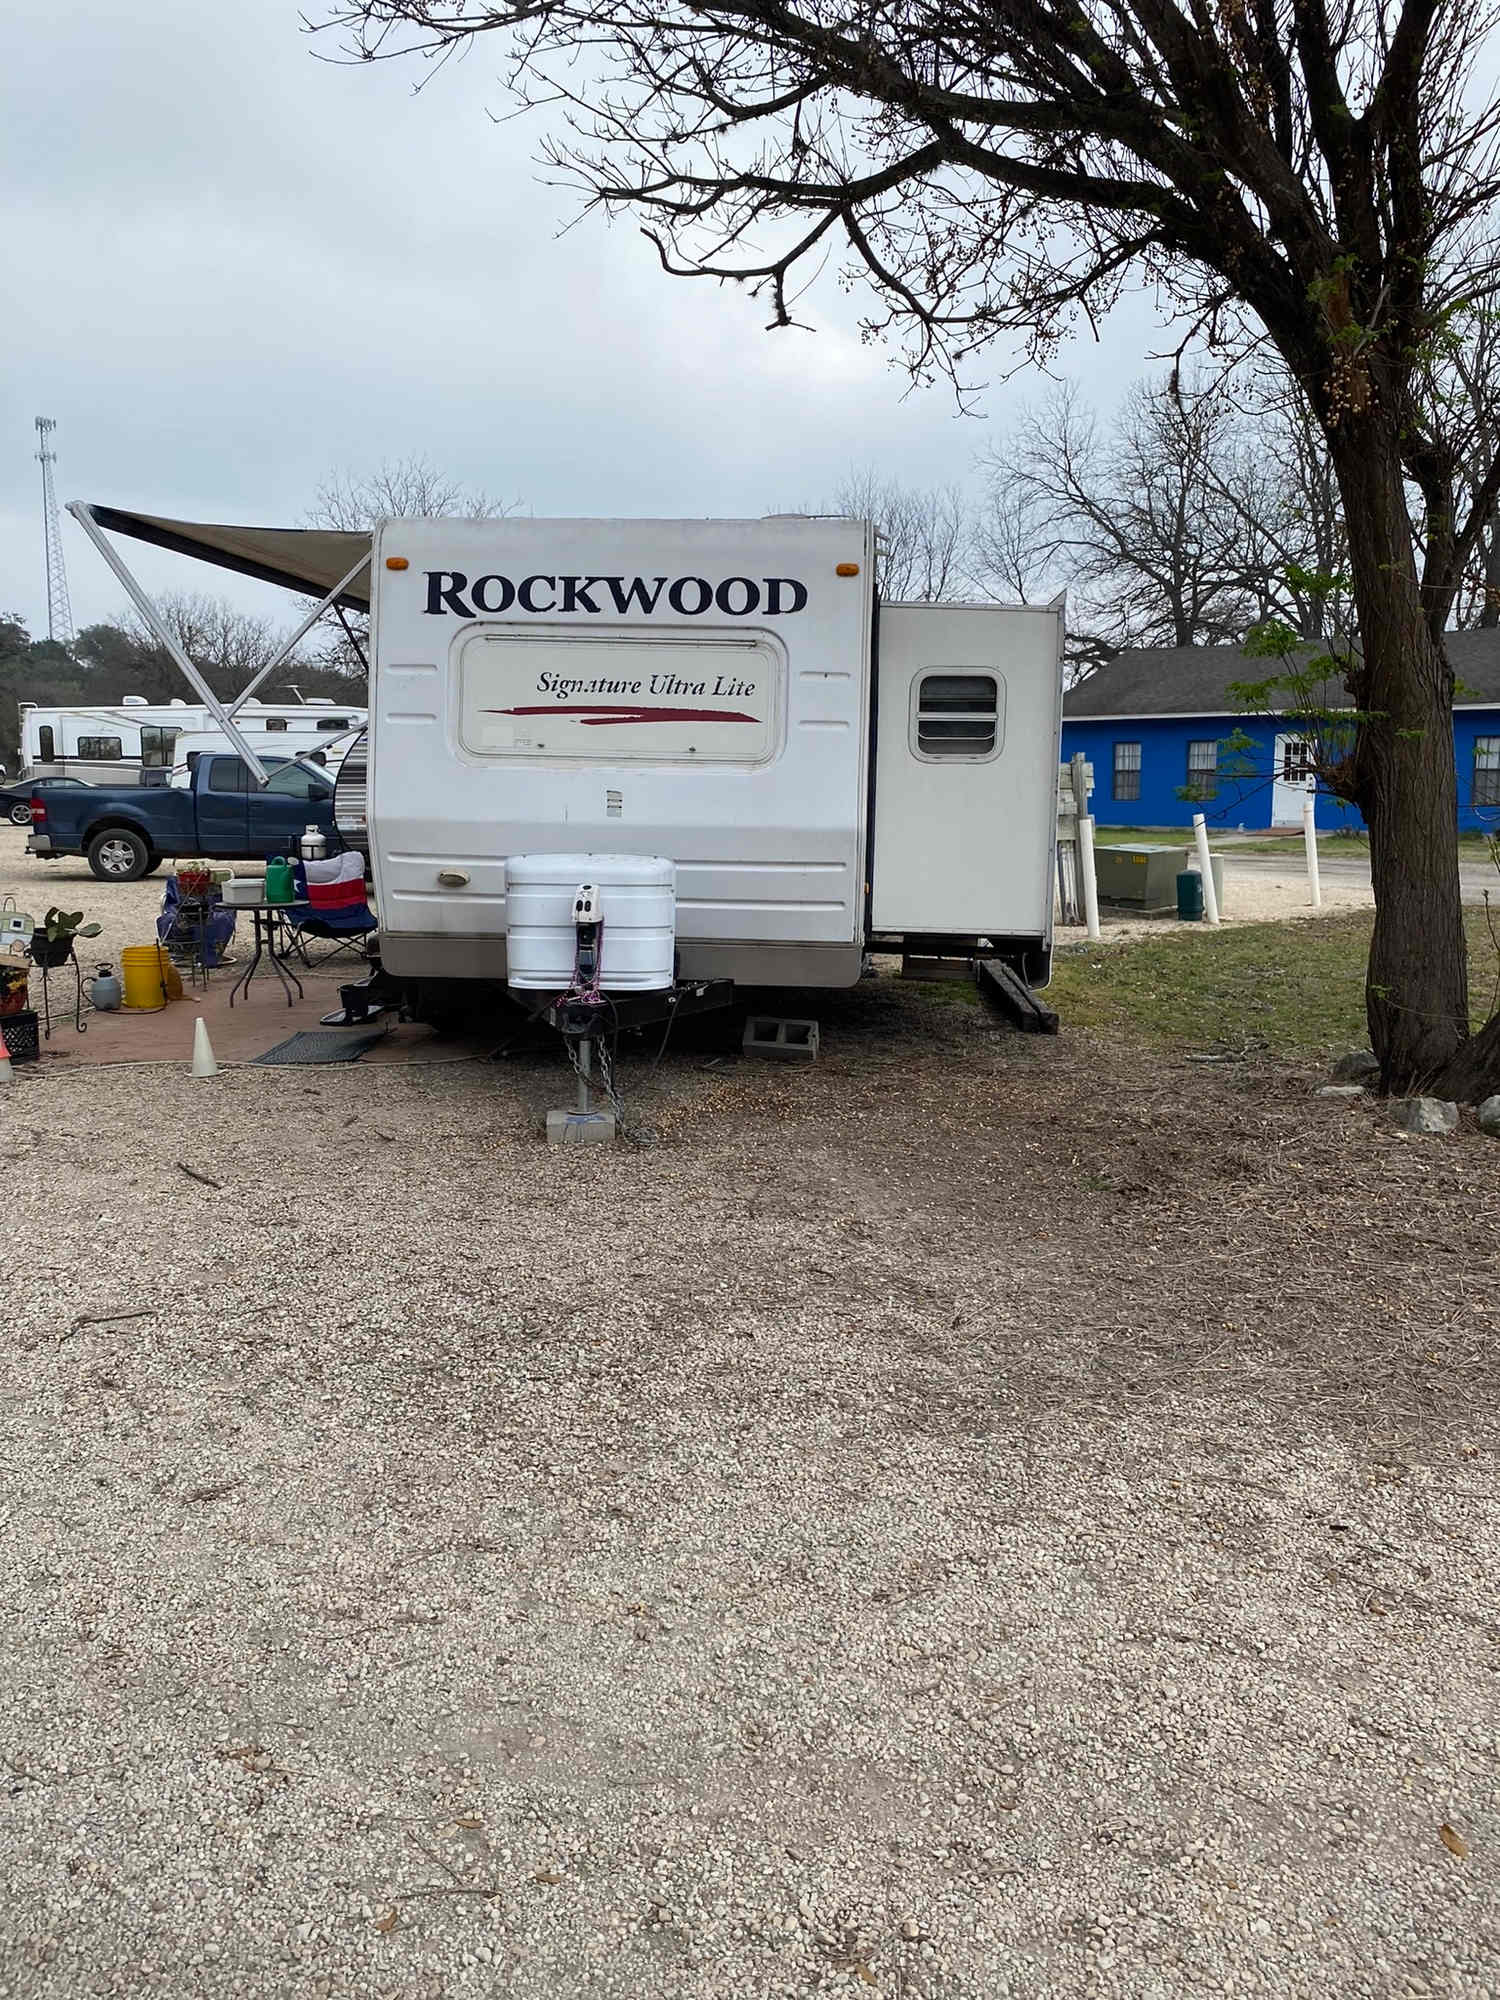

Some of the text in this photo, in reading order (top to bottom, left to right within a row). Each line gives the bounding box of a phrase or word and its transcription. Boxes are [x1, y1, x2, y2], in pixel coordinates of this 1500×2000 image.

[423, 571, 808, 619] ROCKWOOD
[649, 674, 706, 696] Ultra
[711, 675, 756, 697] Lite
